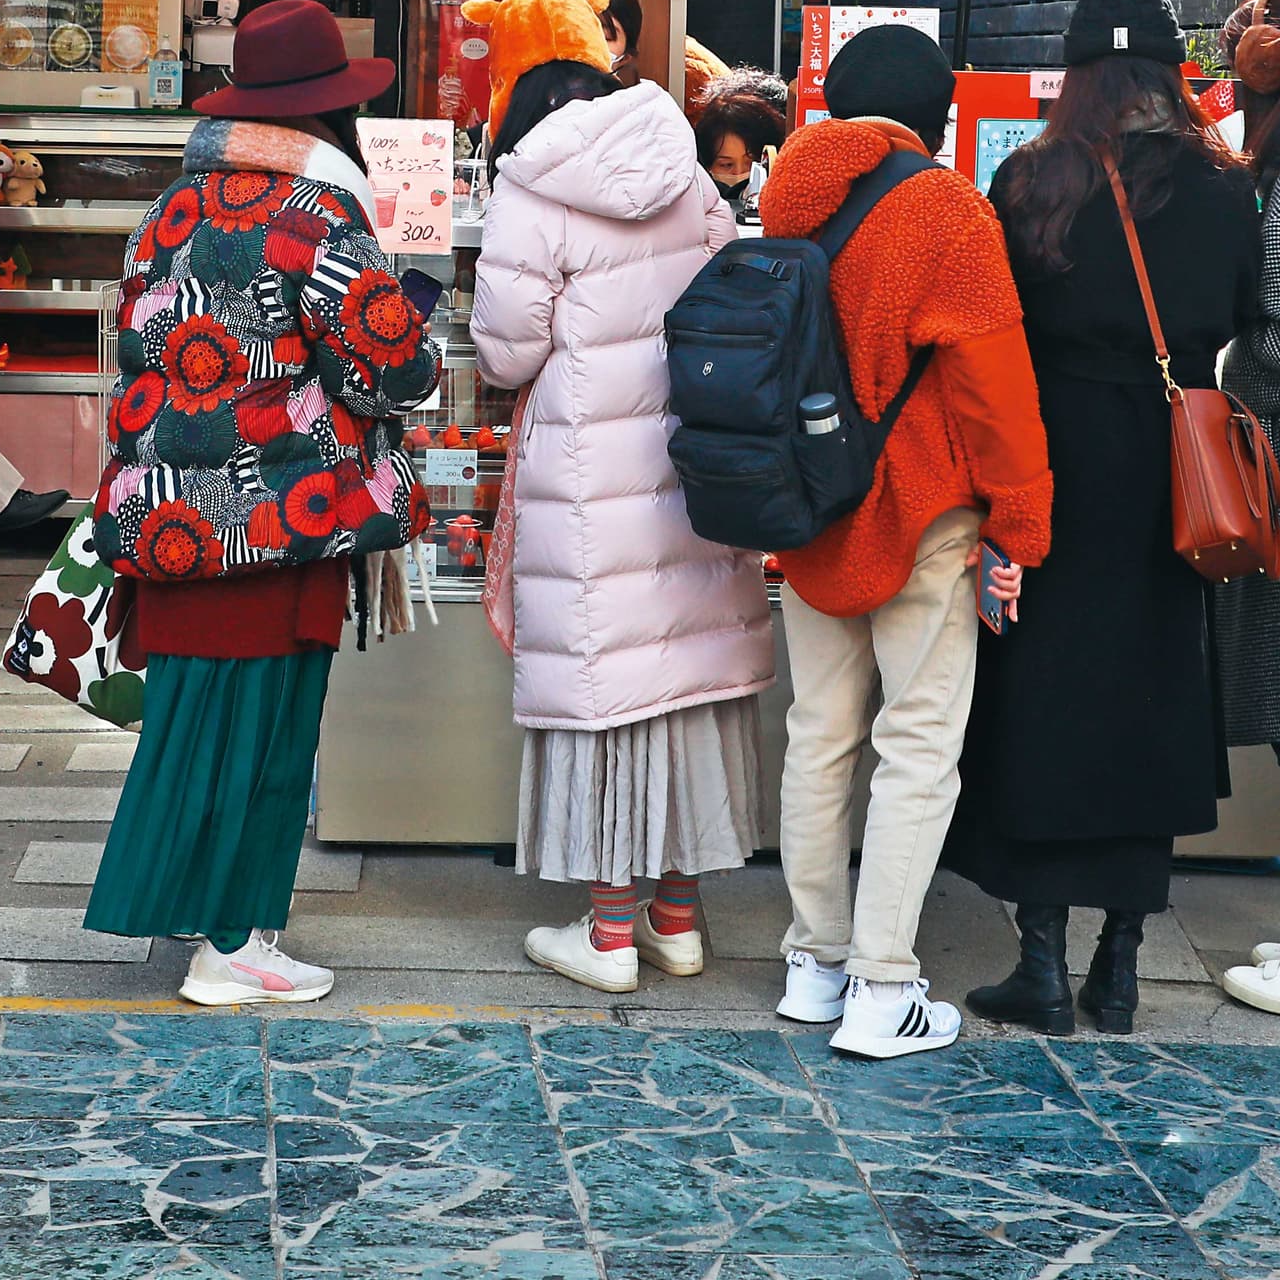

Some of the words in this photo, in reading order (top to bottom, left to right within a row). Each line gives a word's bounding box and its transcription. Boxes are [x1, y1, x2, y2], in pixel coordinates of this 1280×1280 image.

[809, 12, 823, 71] いちご大福
[368, 136, 399, 150] 100%
